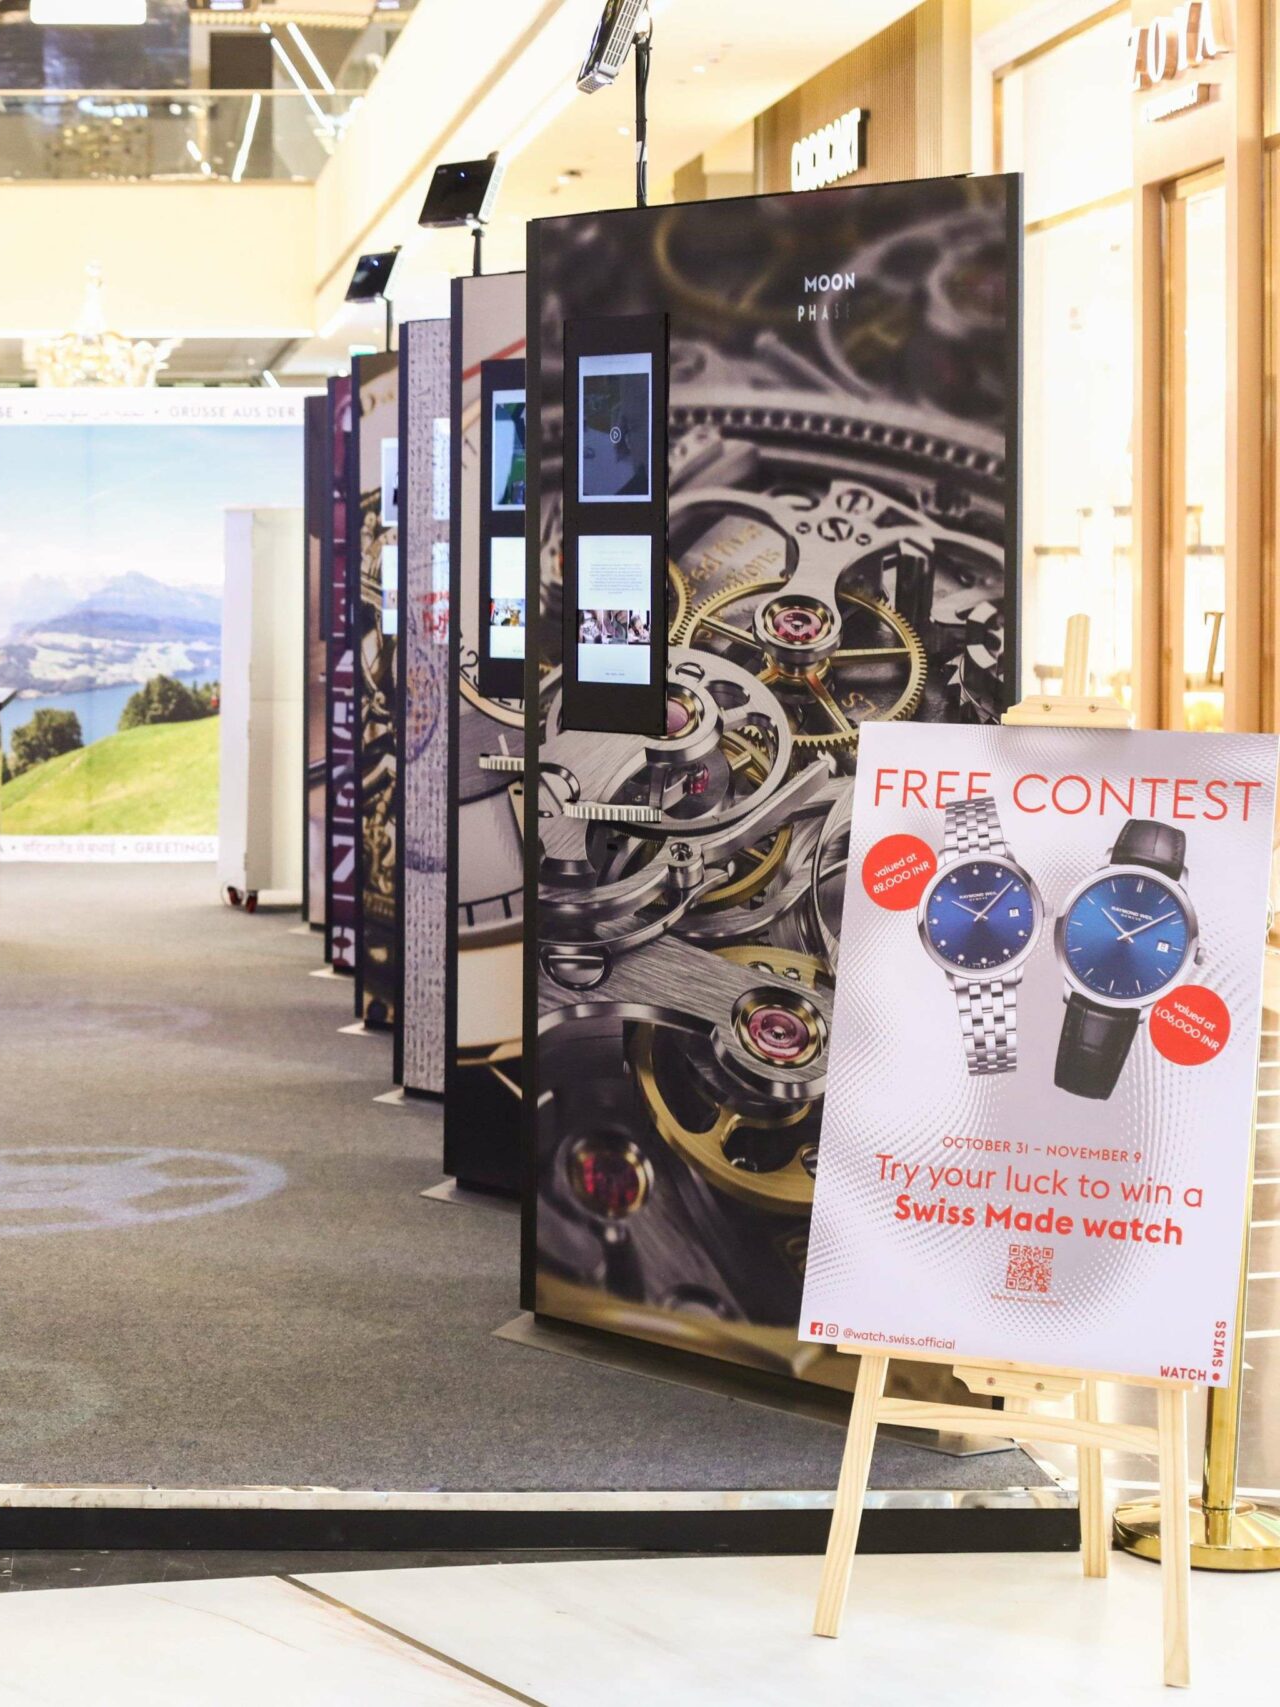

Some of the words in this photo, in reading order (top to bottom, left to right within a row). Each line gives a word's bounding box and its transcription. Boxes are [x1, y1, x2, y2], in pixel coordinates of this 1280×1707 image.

[804, 272, 856, 293] MOON
[232, 406, 262, 418] AUS
[267, 406, 296, 418] DER
[874, 768, 992, 811] FREE
[1012, 773, 1264, 822] CONTEST
[874, 857, 906, 878] valued
[906, 852, 918, 864] at
[912, 860, 932, 877] INR
[1173, 1001, 1206, 1025] valued
[1203, 1021, 1217, 1033] at
[1200, 1034, 1221, 1052] INR
[942, 1135, 1012, 1153] OCTOBER
[1016, 1141, 1029, 1155] 31
[1046, 1144, 1129, 1163] NOVEMBER
[1133, 1151, 1142, 1164] 9
[874, 1152, 920, 1192] Try
[928, 1163, 997, 1192] your
[1004, 1163, 1069, 1199] luck
[1077, 1172, 1113, 1201] to
[1118, 1176, 1174, 1207] win
[1183, 1186, 1205, 1209] a
[893, 1193, 977, 1228] Swiss
[983, 1202, 1075, 1238] Made
[1081, 1214, 1185, 1247] watch
[842, 1326, 957, 1351] @watch.swiss.official
[1211, 1320, 1227, 1369] SWISS
[1159, 1365, 1208, 1382] WATCH
